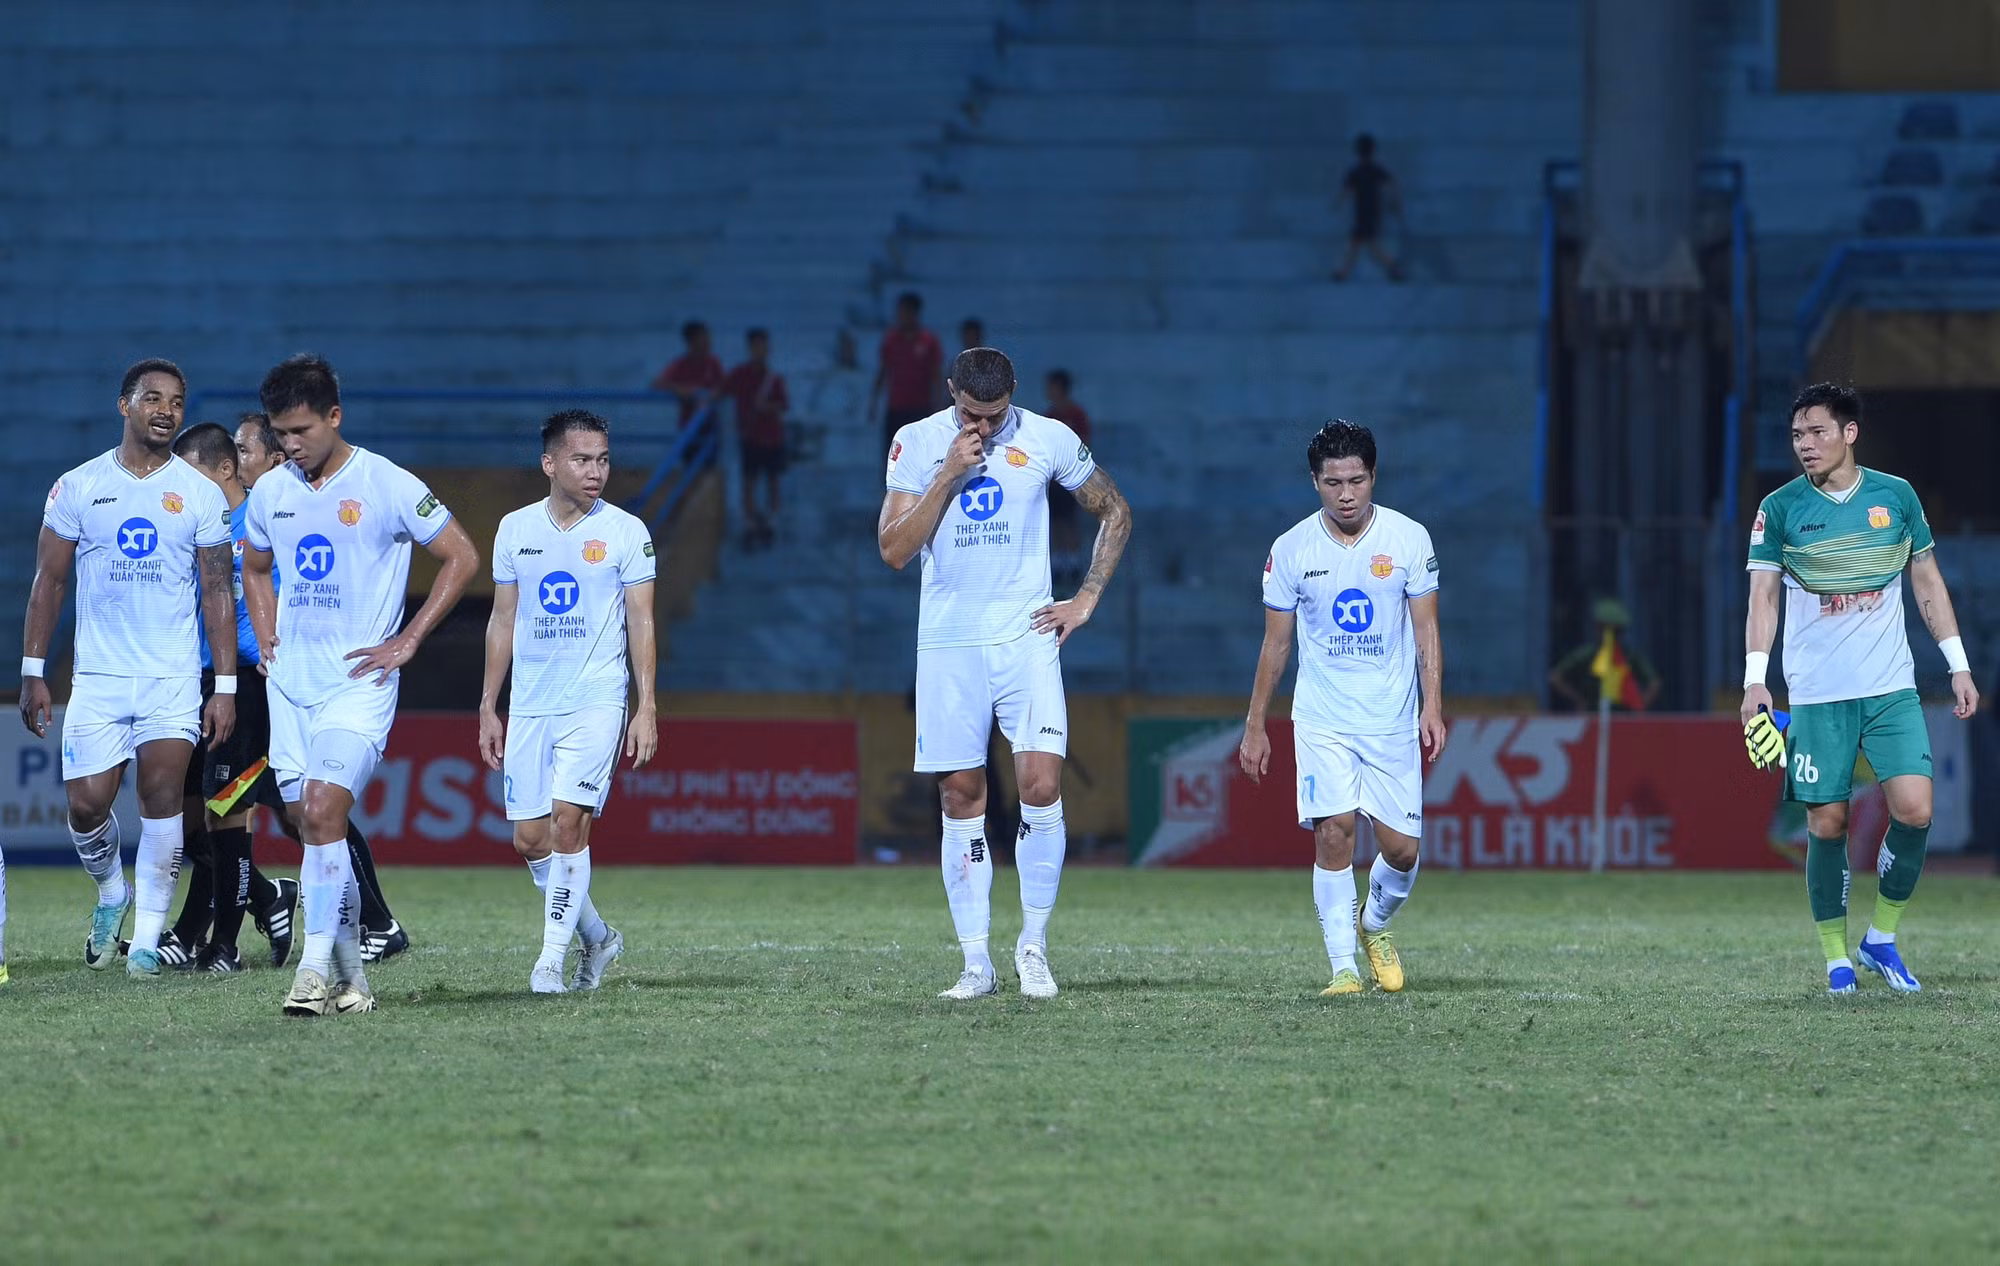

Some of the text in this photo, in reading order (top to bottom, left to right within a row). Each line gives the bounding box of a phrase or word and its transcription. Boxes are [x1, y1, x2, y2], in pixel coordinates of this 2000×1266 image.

[92, 496, 117, 506] Mitre
[273, 510, 295, 520] Mitre
[955, 520, 1009, 535] THÉP XANH
[1799, 522, 1826, 533] Mitre
[518, 547, 544, 556] Mitre
[111, 558, 162, 571] THÉP XANH
[1303, 569, 1329, 579] Mitre
[313, 584, 340, 595] XANH
[534, 614, 585, 627] THÉP XANH
[1329, 632, 1382, 645] THÉP XANH
[1039, 726, 1063, 737] Mitre
[1794, 753, 1819, 783] 26
[505, 775, 516, 802] 2
[235, 857, 250, 907] JOGARBOLA
[550, 886, 574, 921] mitre
